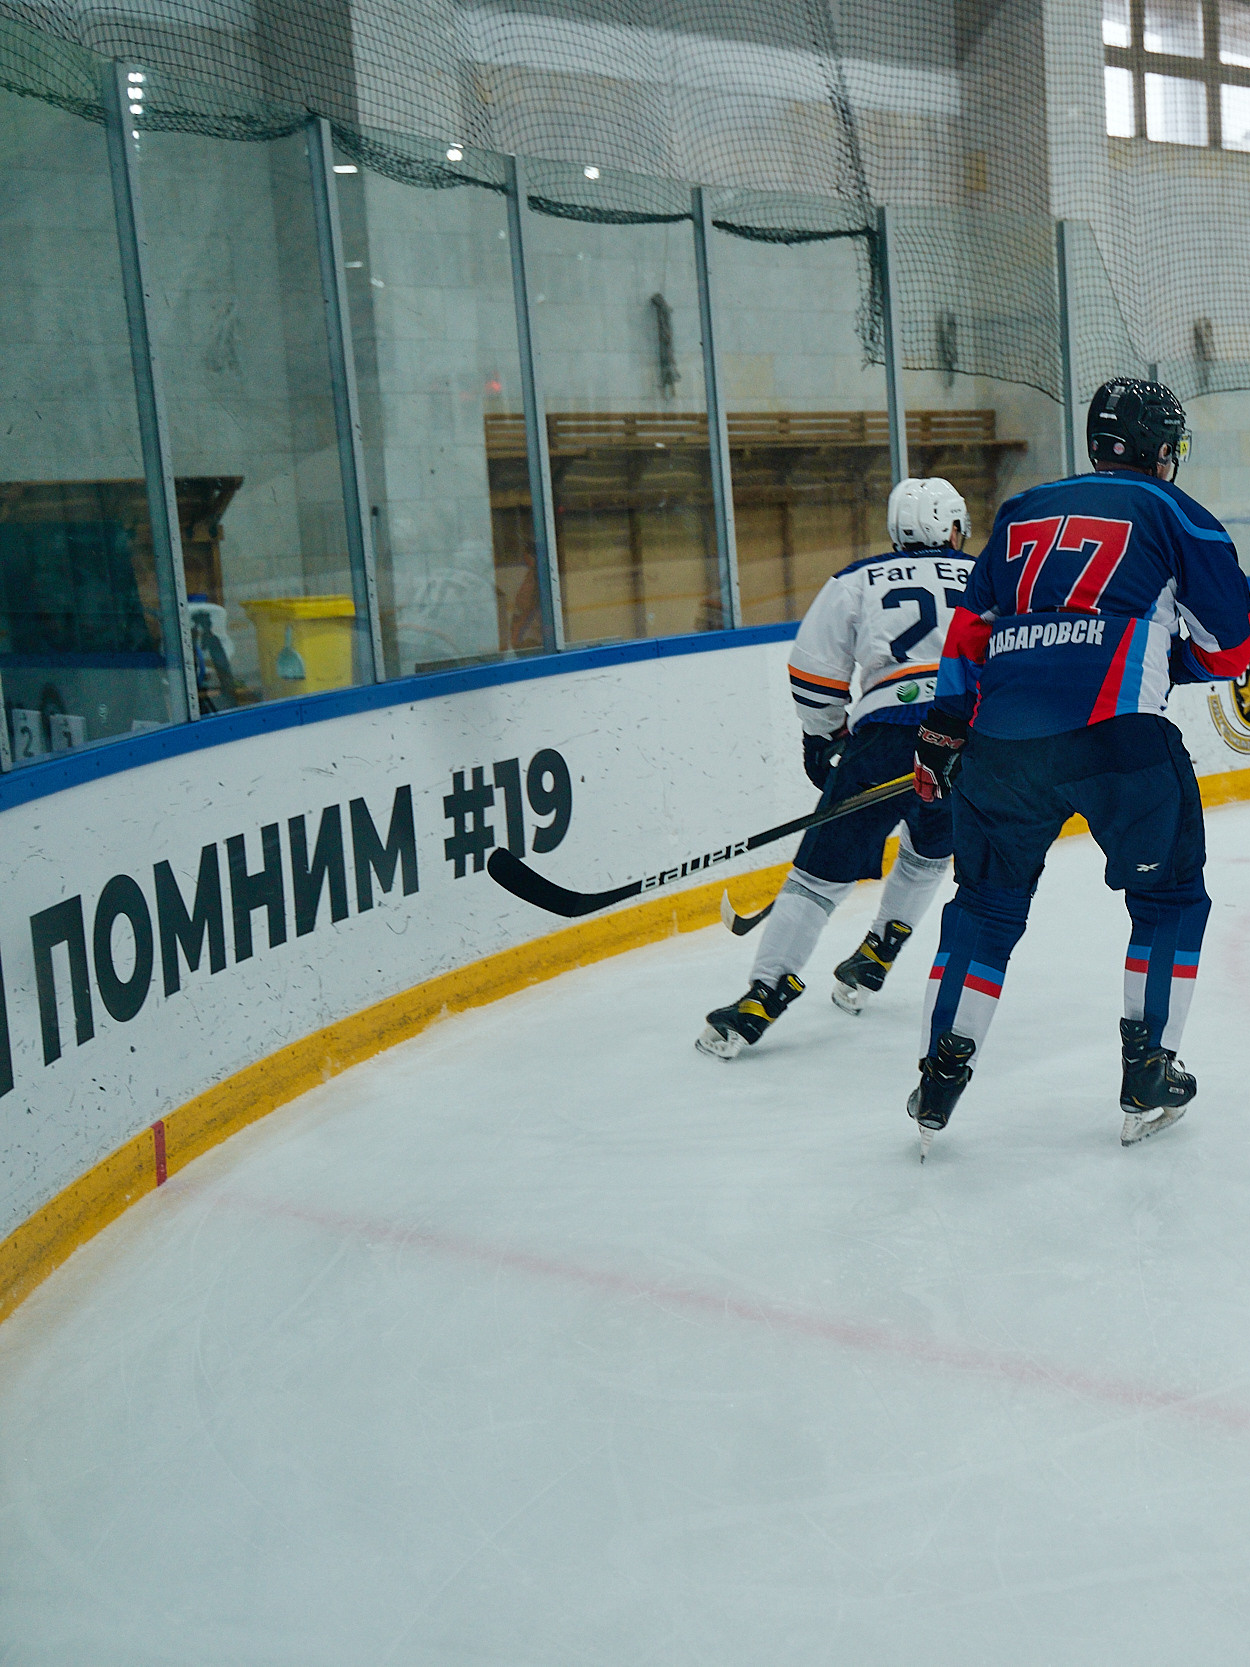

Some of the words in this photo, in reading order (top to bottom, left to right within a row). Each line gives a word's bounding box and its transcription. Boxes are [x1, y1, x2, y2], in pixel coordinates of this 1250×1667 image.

[867, 566, 917, 586] Far
[934, 563, 969, 584] Ea
[1006, 515, 1133, 616] 77
[988, 619, 1106, 659] ХАБАРОВСК
[640, 841, 749, 893] BAUER
[29, 784, 420, 1067] ПОМНИМ
[442, 748, 572, 880] #19
